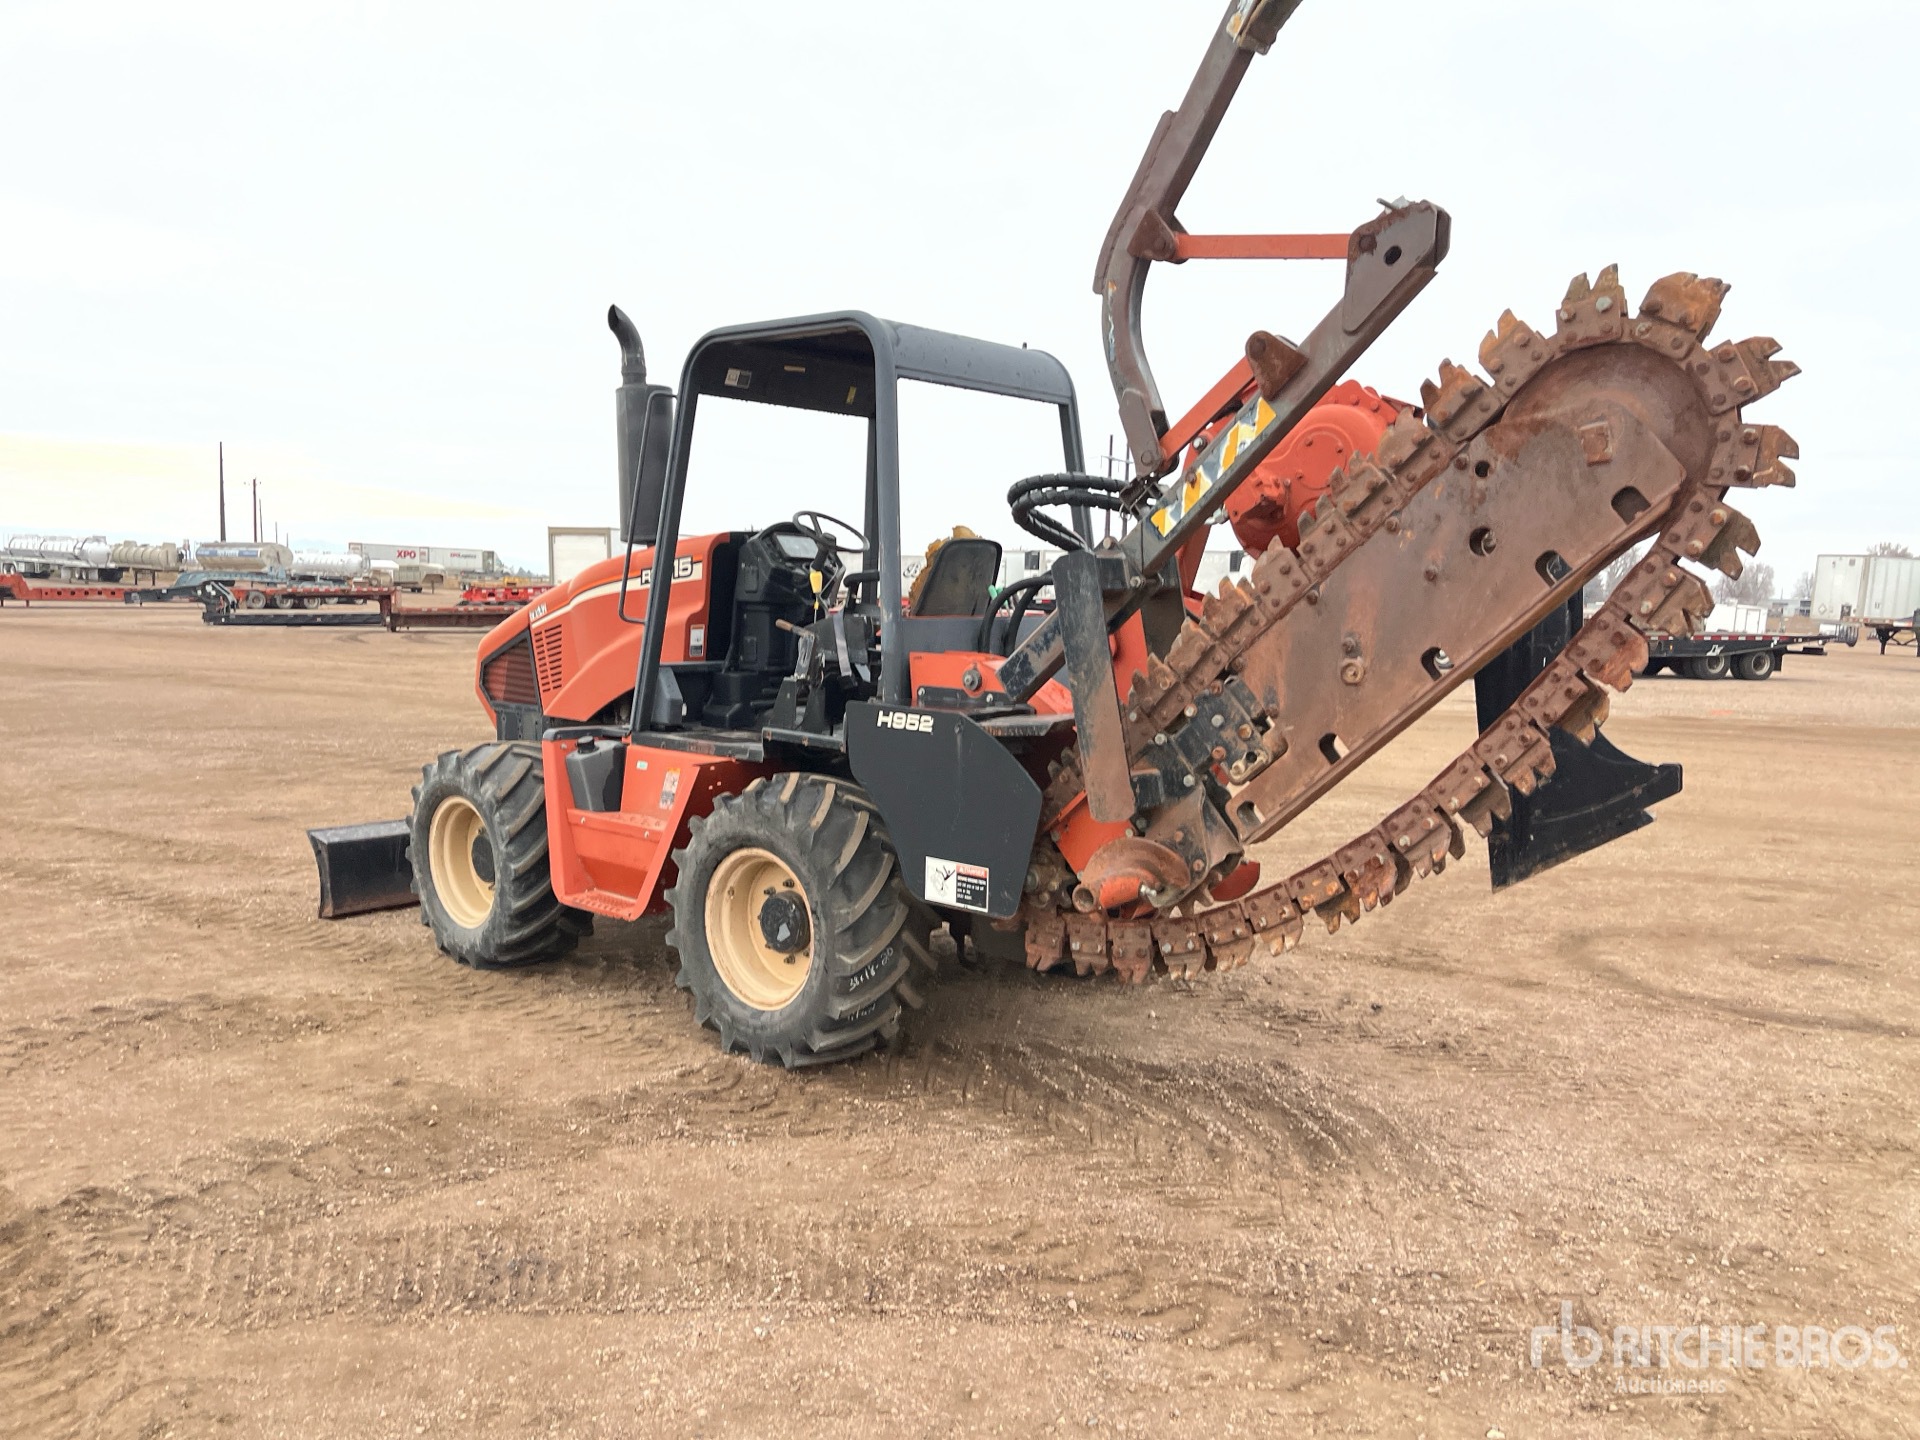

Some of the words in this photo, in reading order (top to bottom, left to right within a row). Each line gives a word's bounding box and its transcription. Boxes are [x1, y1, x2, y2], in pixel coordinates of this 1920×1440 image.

[396, 549, 416, 559] XPO
[641, 556, 693, 585] R15
[876, 710, 934, 733] H952
